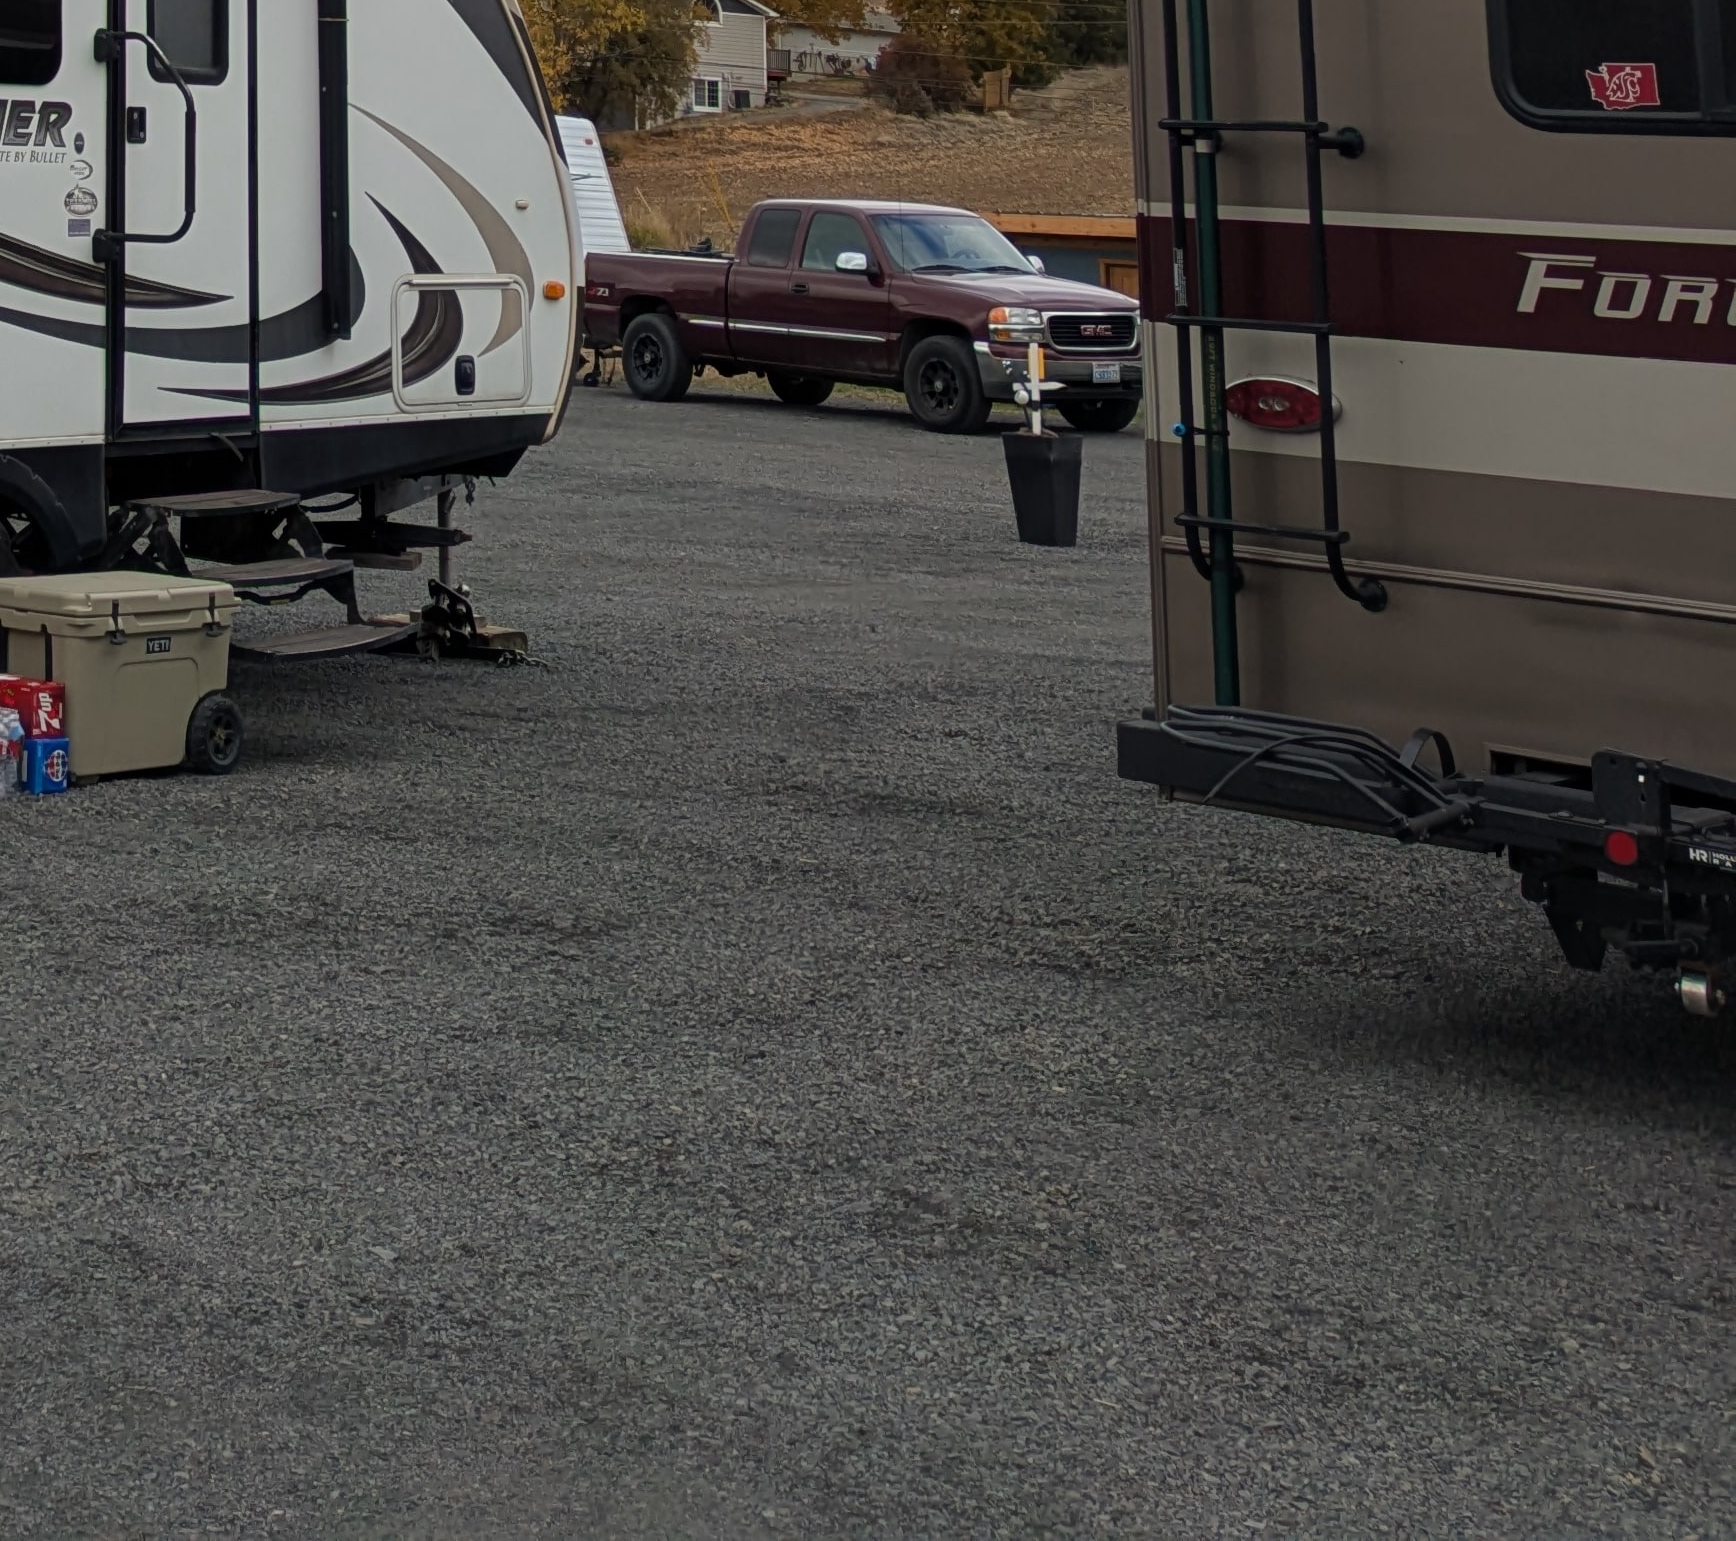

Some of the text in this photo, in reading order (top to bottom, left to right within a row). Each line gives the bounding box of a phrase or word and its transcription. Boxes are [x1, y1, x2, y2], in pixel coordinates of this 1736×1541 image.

[29, 150, 67, 164] BULLET
[1516, 251, 1736, 326] FOR
[1080, 325, 1112, 336] GMC
[148, 639, 169, 652] YETI
